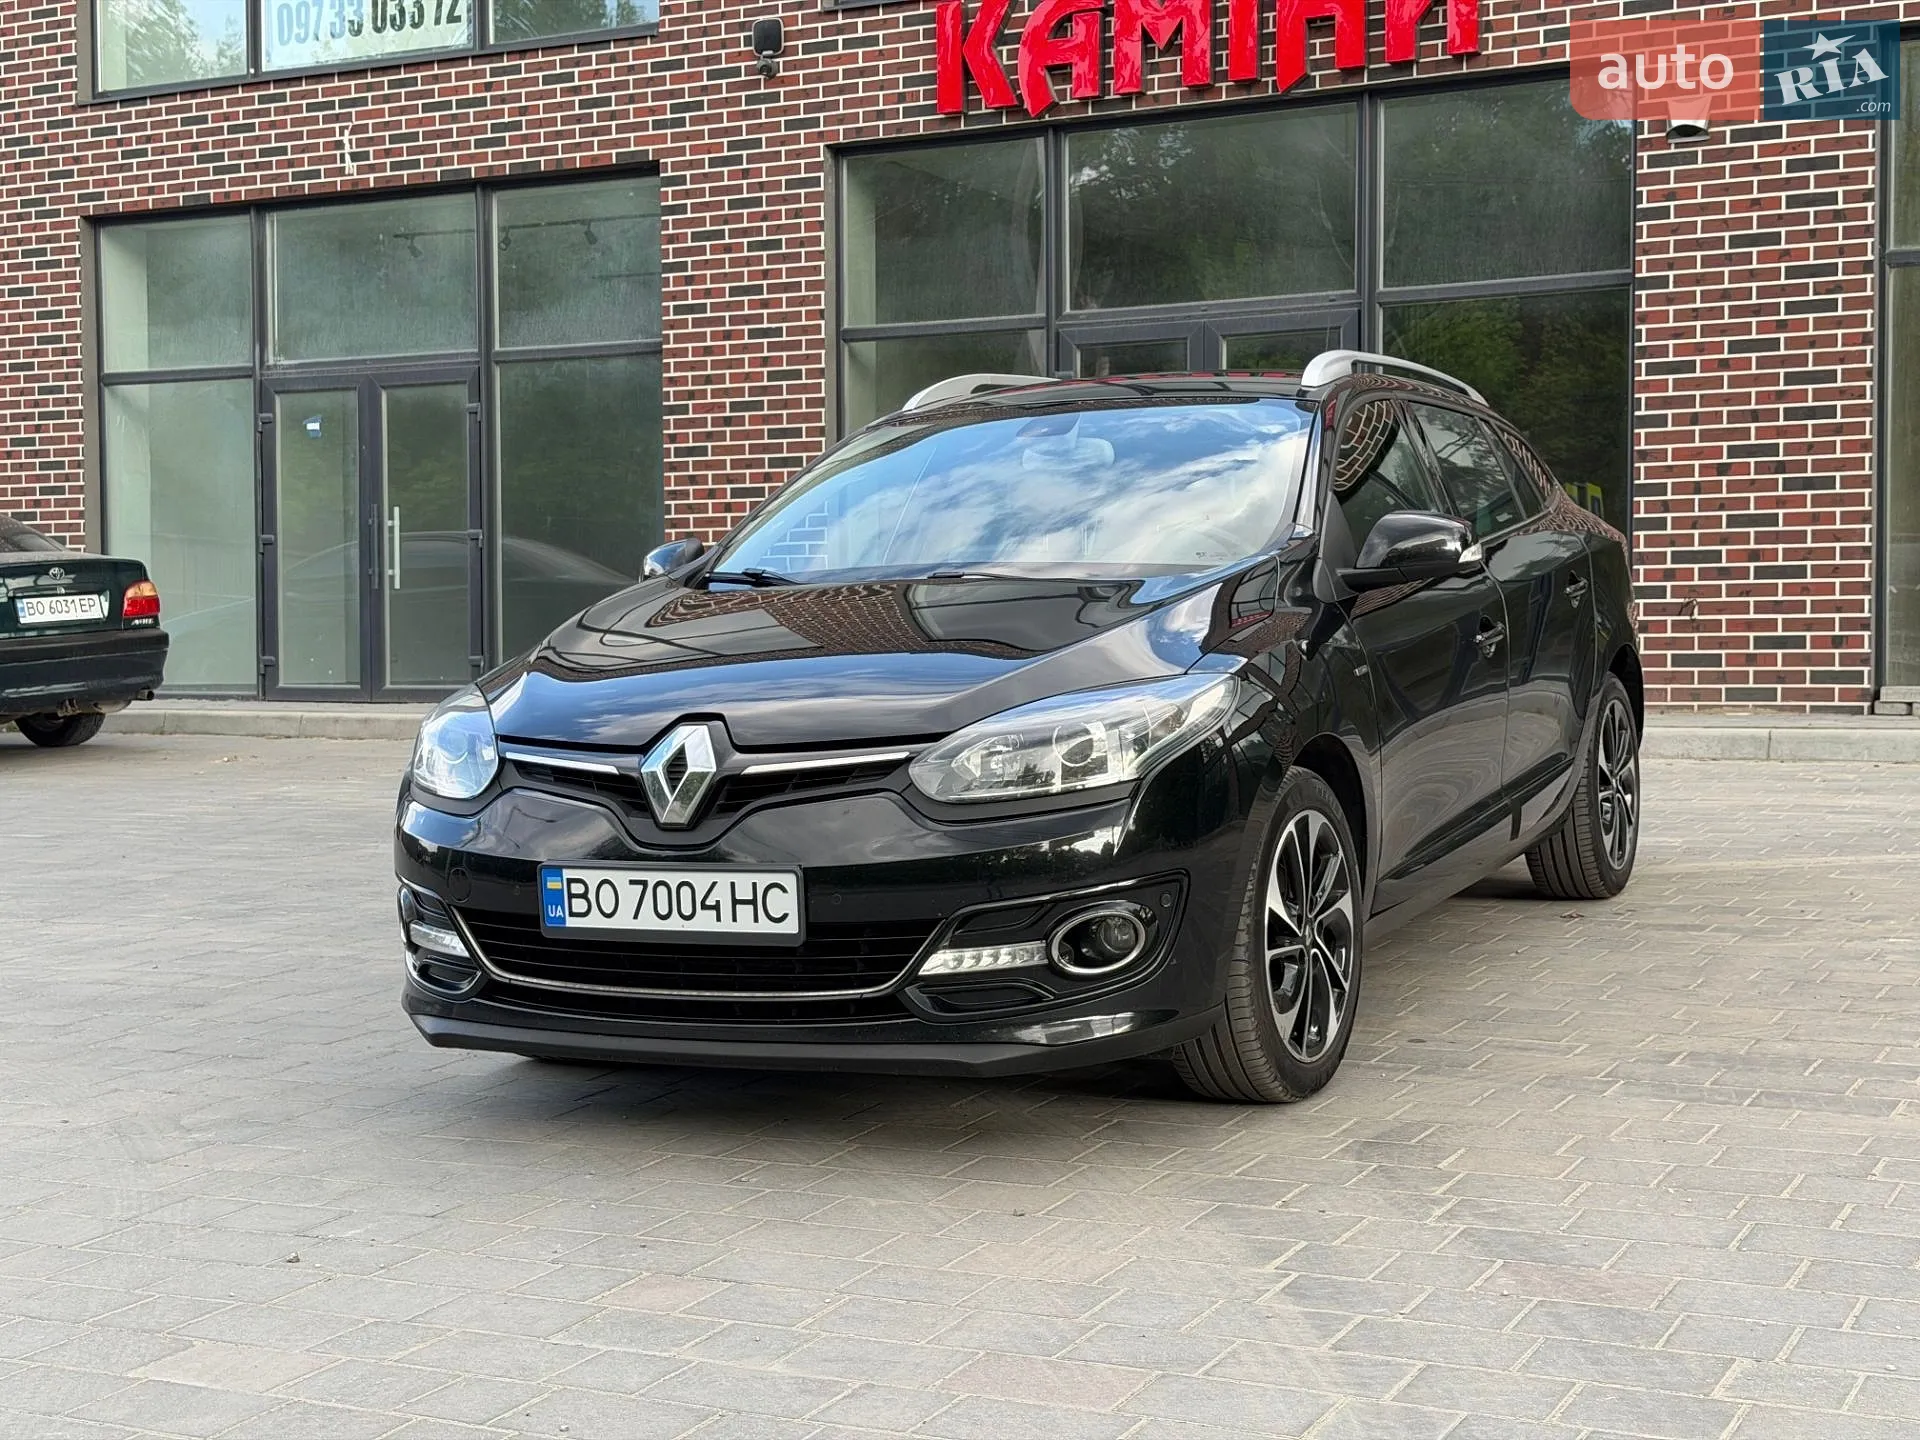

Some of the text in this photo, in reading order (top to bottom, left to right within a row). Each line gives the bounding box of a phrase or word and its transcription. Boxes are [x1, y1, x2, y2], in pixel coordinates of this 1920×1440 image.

[25, 598, 96, 616] BO 6031 EP
[566, 877, 790, 924] BO 7004 HC
[548, 905, 564, 918] UA
